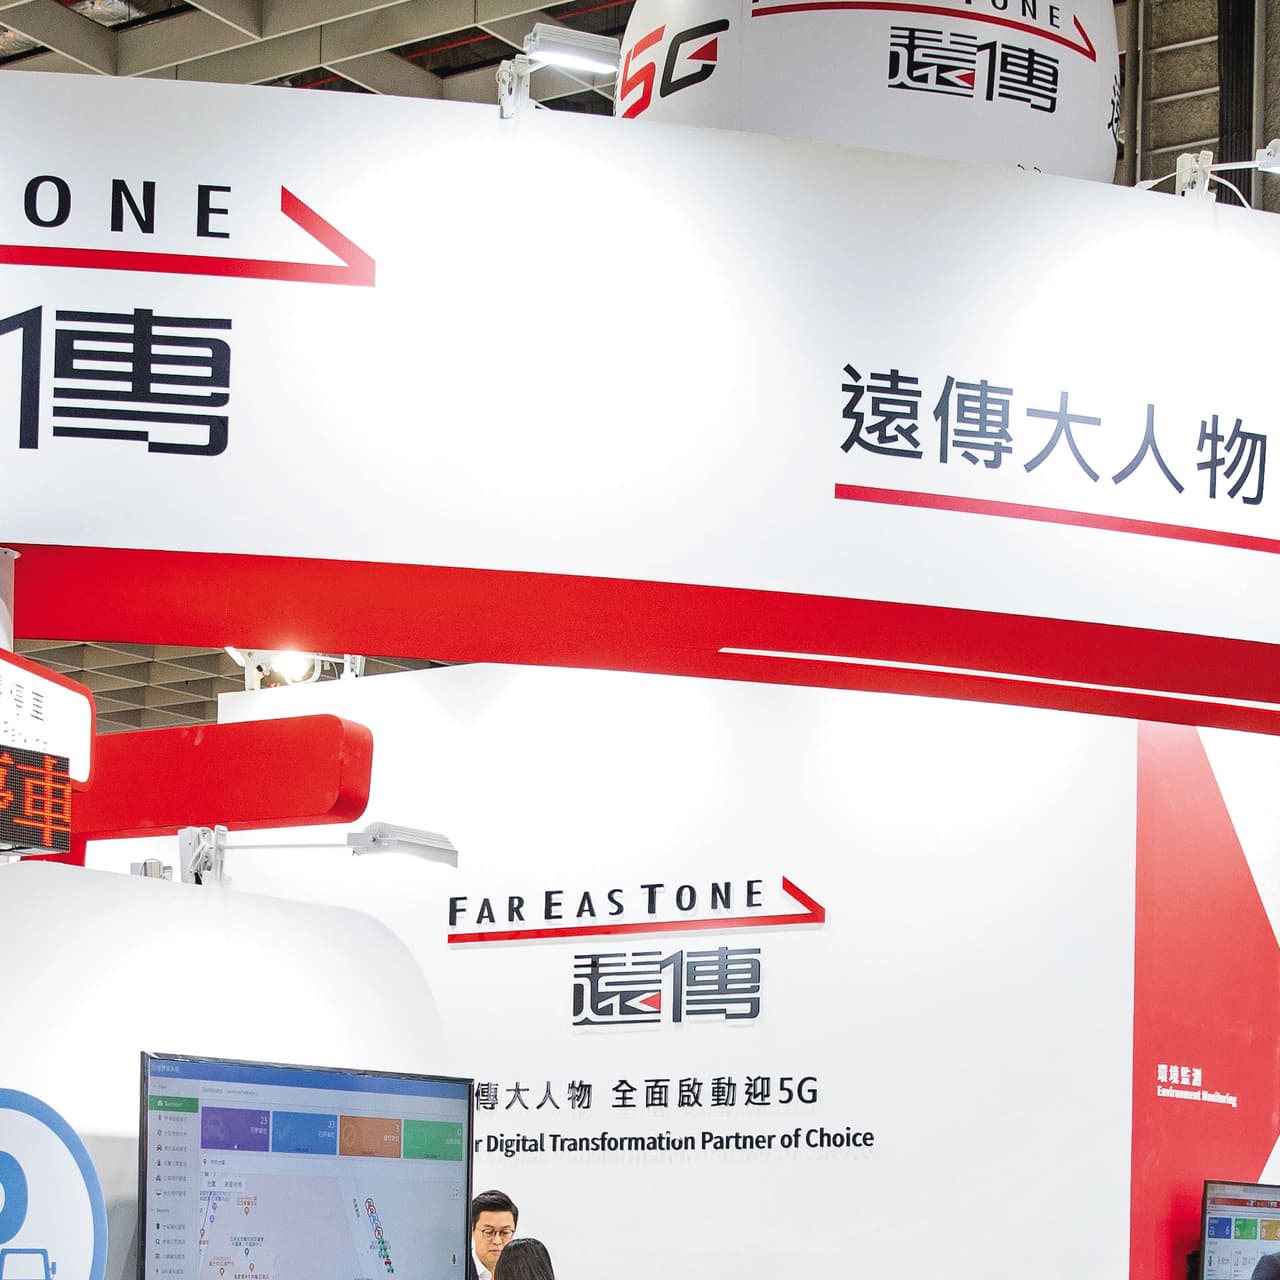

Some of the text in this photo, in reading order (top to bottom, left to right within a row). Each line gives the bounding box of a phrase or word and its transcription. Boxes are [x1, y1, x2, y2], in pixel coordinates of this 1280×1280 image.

[619, 19, 729, 118] 5G
[888, 26, 1058, 113] 遠傳
[840, 364, 1266, 505] 遠傳大人物
[449, 879, 762, 926] FAREASTONE
[573, 947, 761, 1025] 遠傳
[612, 1075, 818, 1109] 全面啟動迎5G
[487, 1132, 544, 1157] Digital
[549, 1130, 696, 1152] Transformation
[701, 1131, 775, 1150] Partner
[780, 1128, 801, 1148] of
[805, 1126, 874, 1148] Choice
